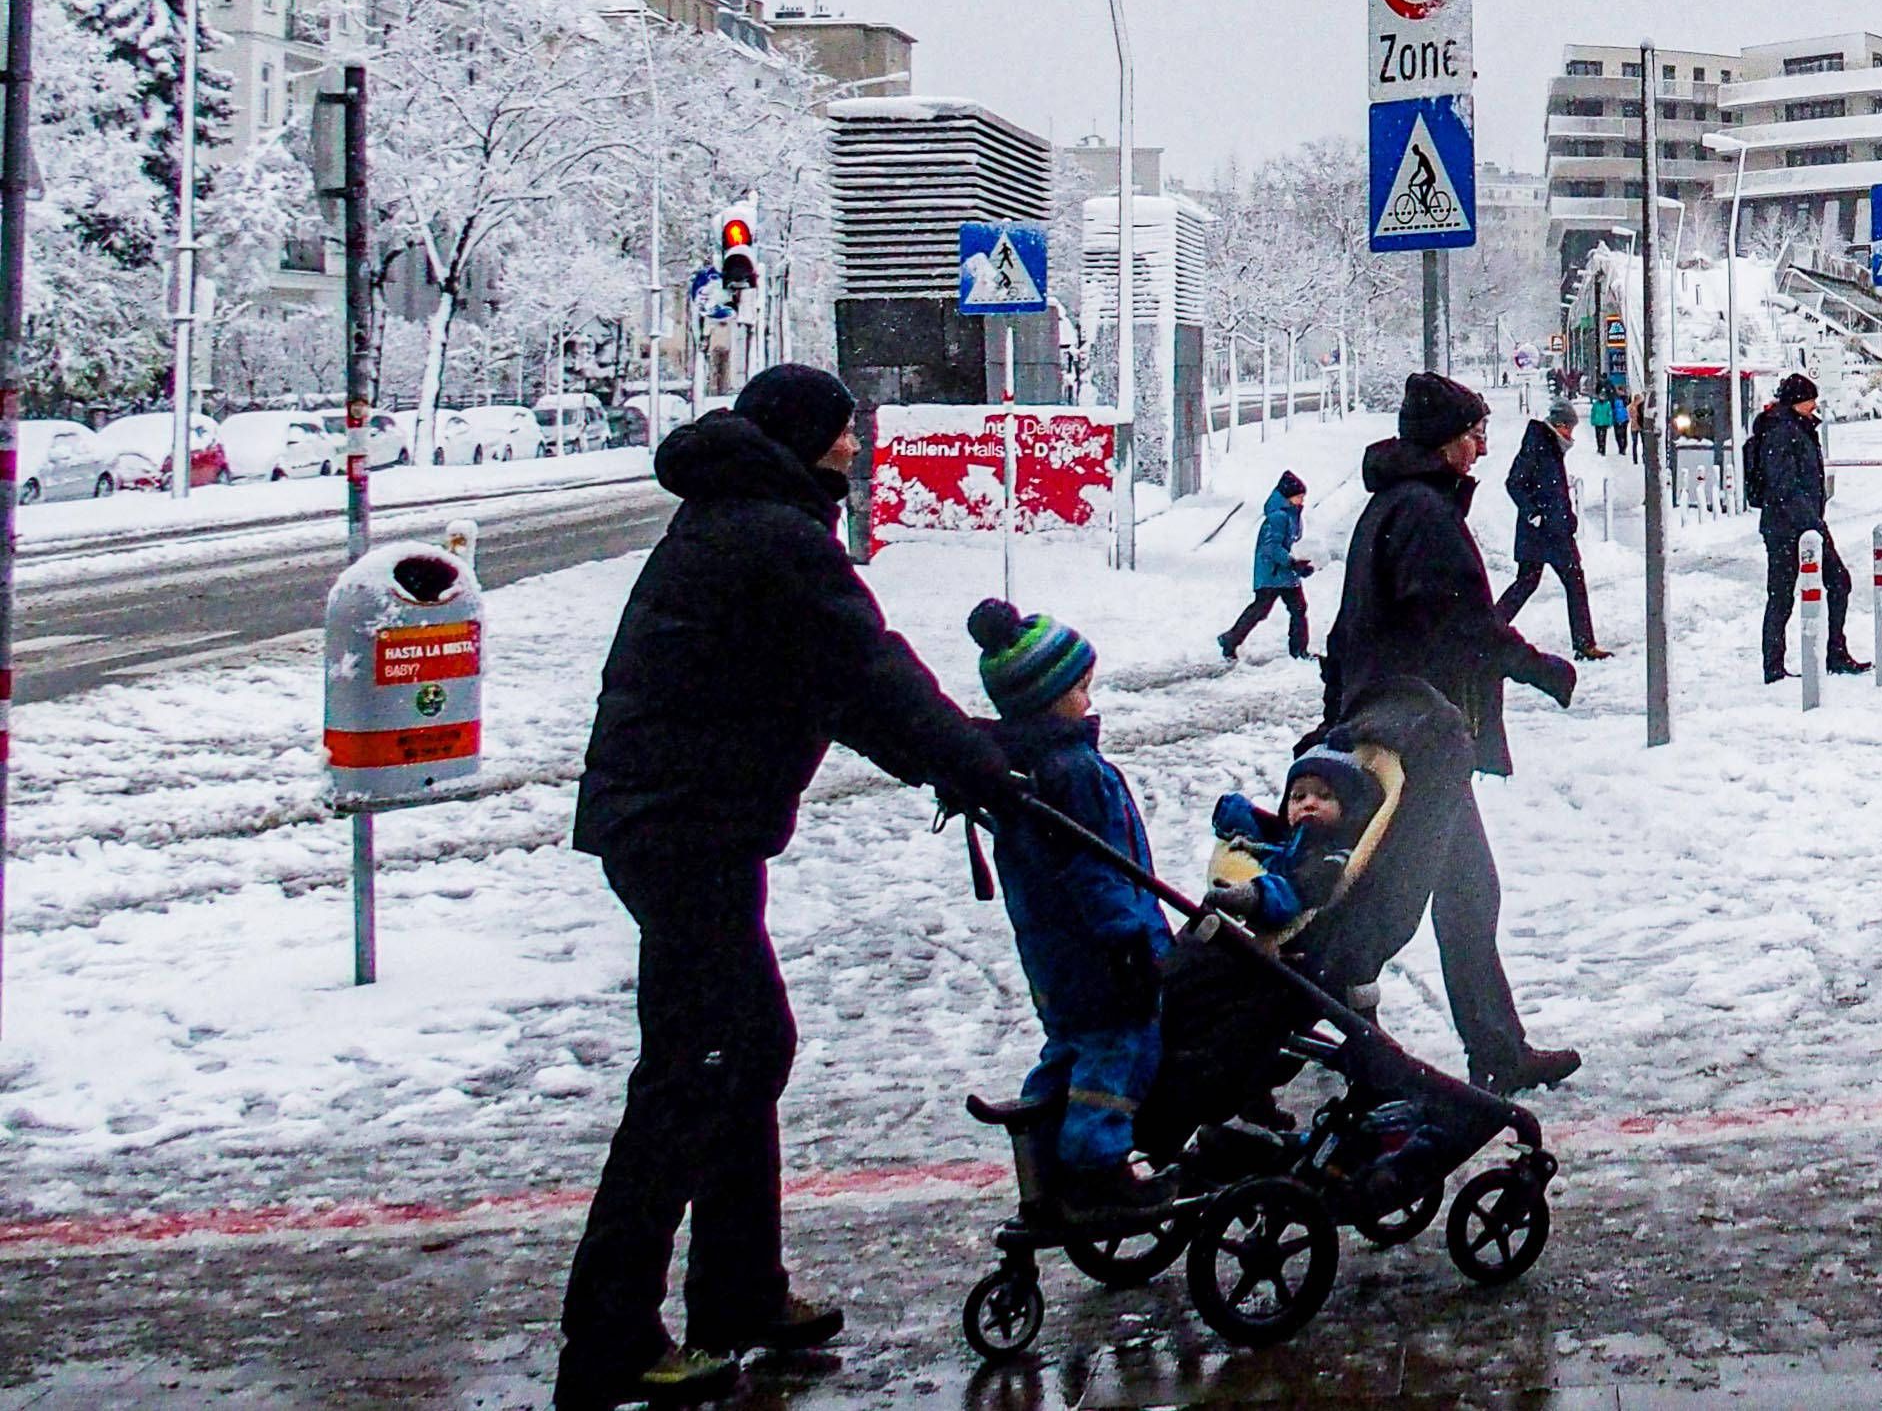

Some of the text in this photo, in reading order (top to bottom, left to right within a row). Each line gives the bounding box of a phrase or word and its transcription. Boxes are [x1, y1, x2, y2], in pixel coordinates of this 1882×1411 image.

[1379, 34, 1458, 83] Zone
[1024, 420, 1088, 438] Delivery
[385, 646, 424, 660] HASTA
[425, 644, 441, 657] LA
[385, 663, 421, 678] BABY?
